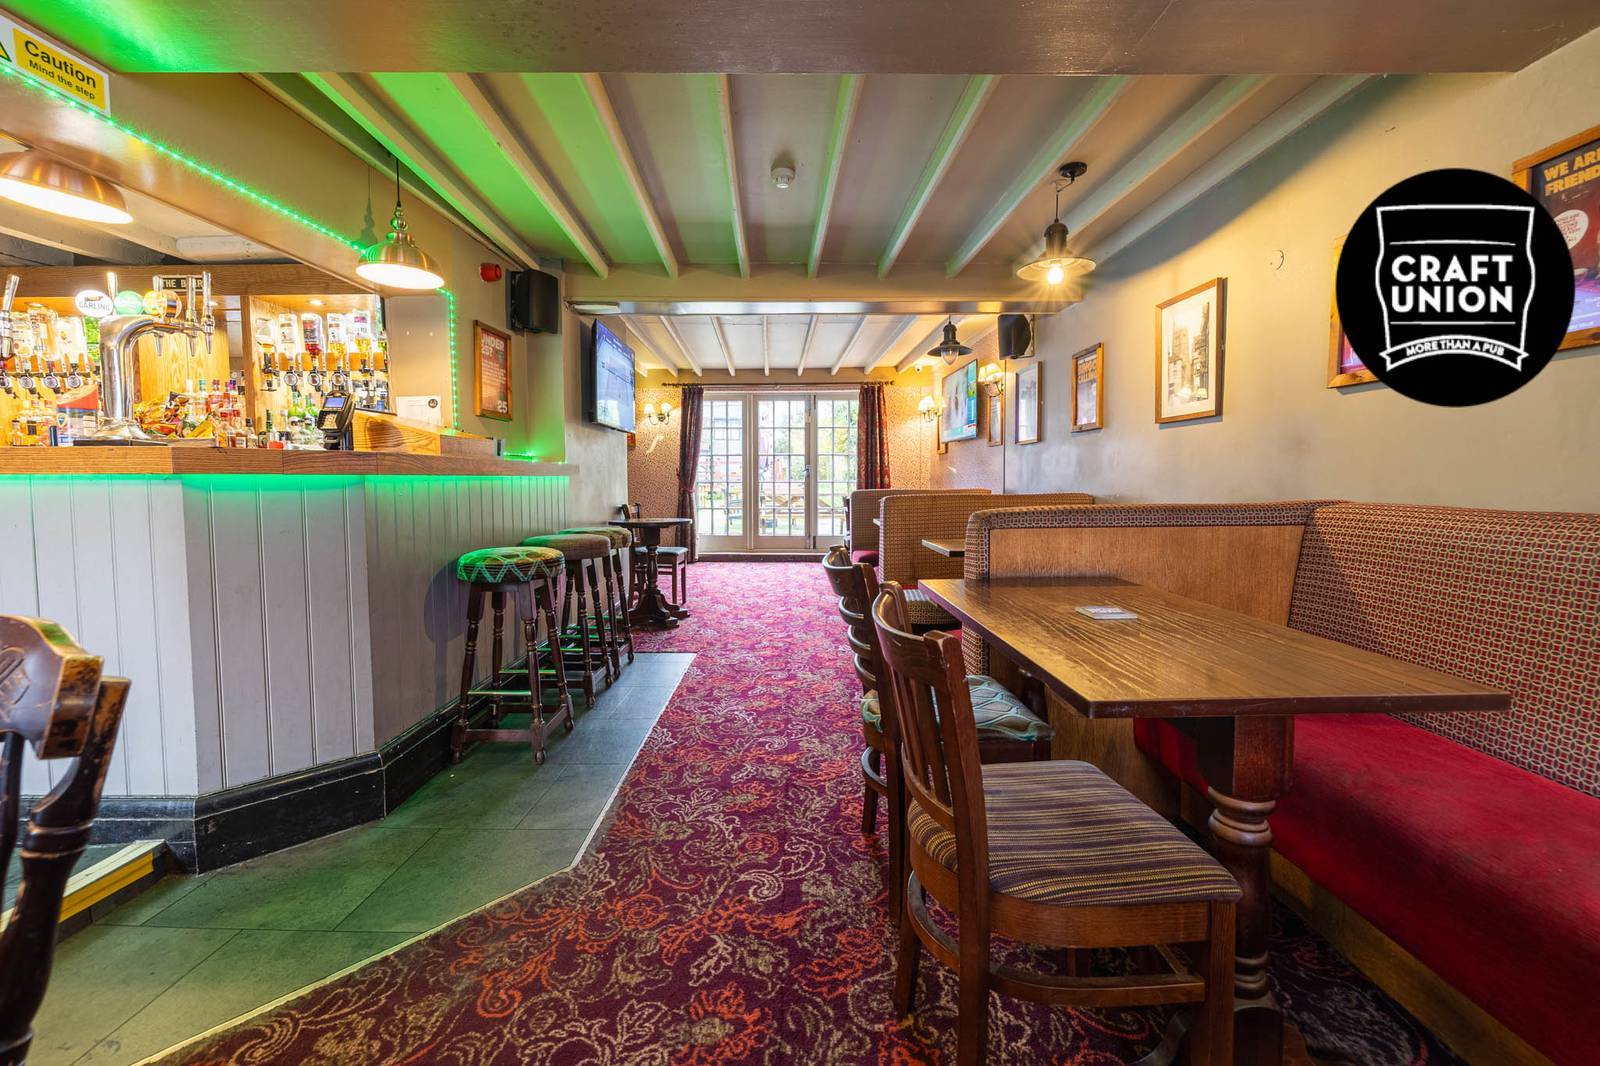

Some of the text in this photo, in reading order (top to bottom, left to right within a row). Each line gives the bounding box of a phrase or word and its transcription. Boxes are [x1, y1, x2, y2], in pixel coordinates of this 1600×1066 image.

[24, 40, 97, 89] Caution
[29, 59, 96, 100] Mind the step
[1543, 160, 1569, 182] WE
[78, 301, 111, 311] CARLING
